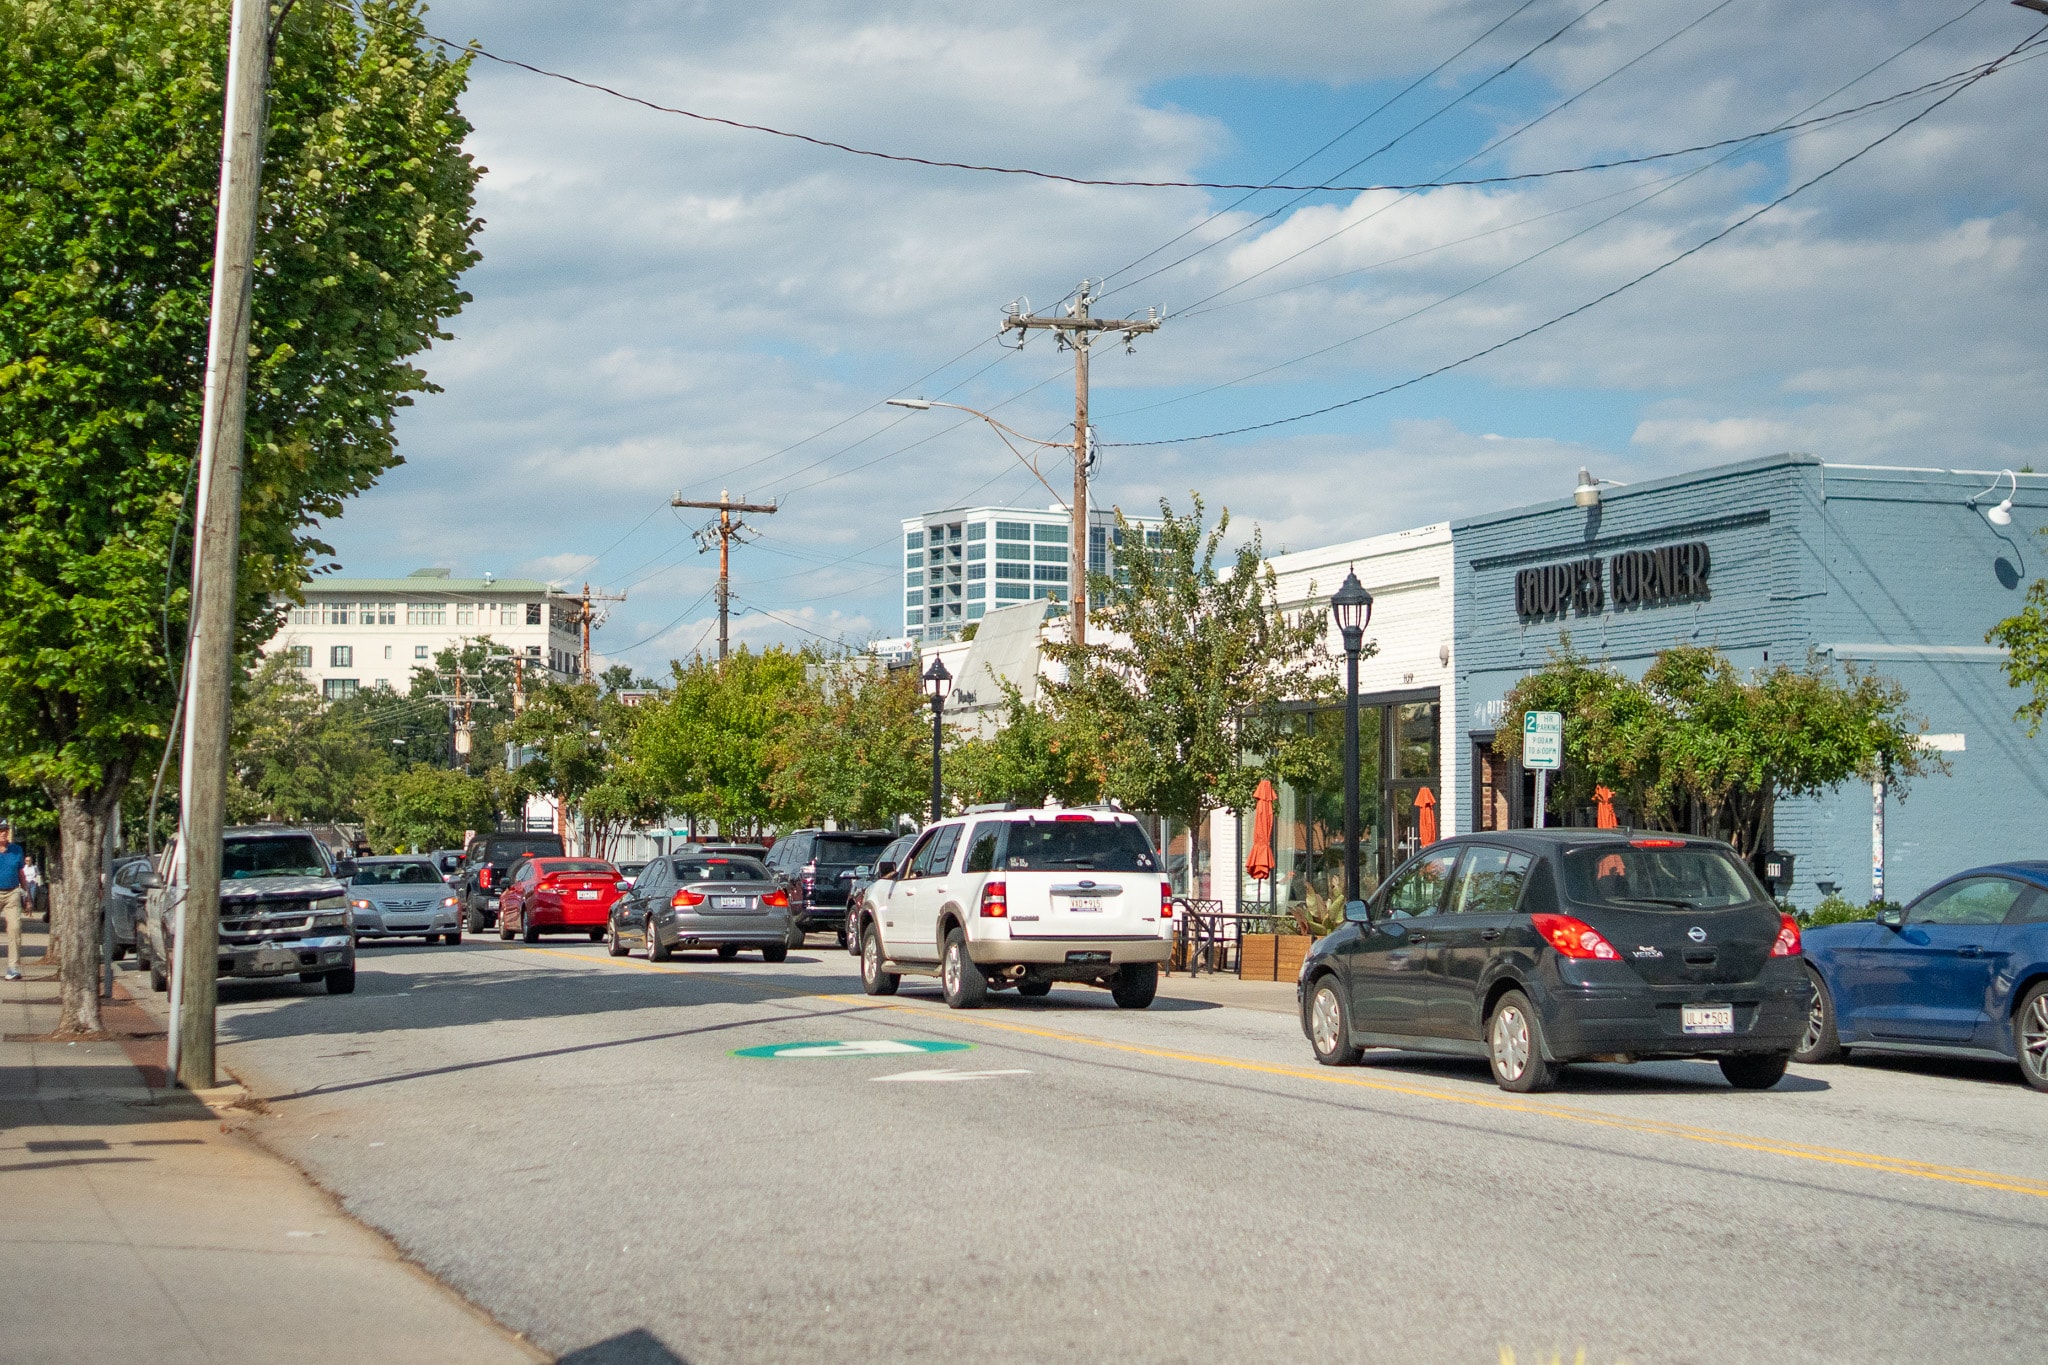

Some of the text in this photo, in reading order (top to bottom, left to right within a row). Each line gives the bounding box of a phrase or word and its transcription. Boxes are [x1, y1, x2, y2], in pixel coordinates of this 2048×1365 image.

[1610, 542, 1712, 605] CORNER
[1403, 672, 1414, 685] 109
[1527, 715, 1554, 730] 2 HR
[1767, 863, 1780, 877] 111
[1632, 950, 1664, 958] VERSA
[1686, 1011, 1729, 1025] ULJ 503
